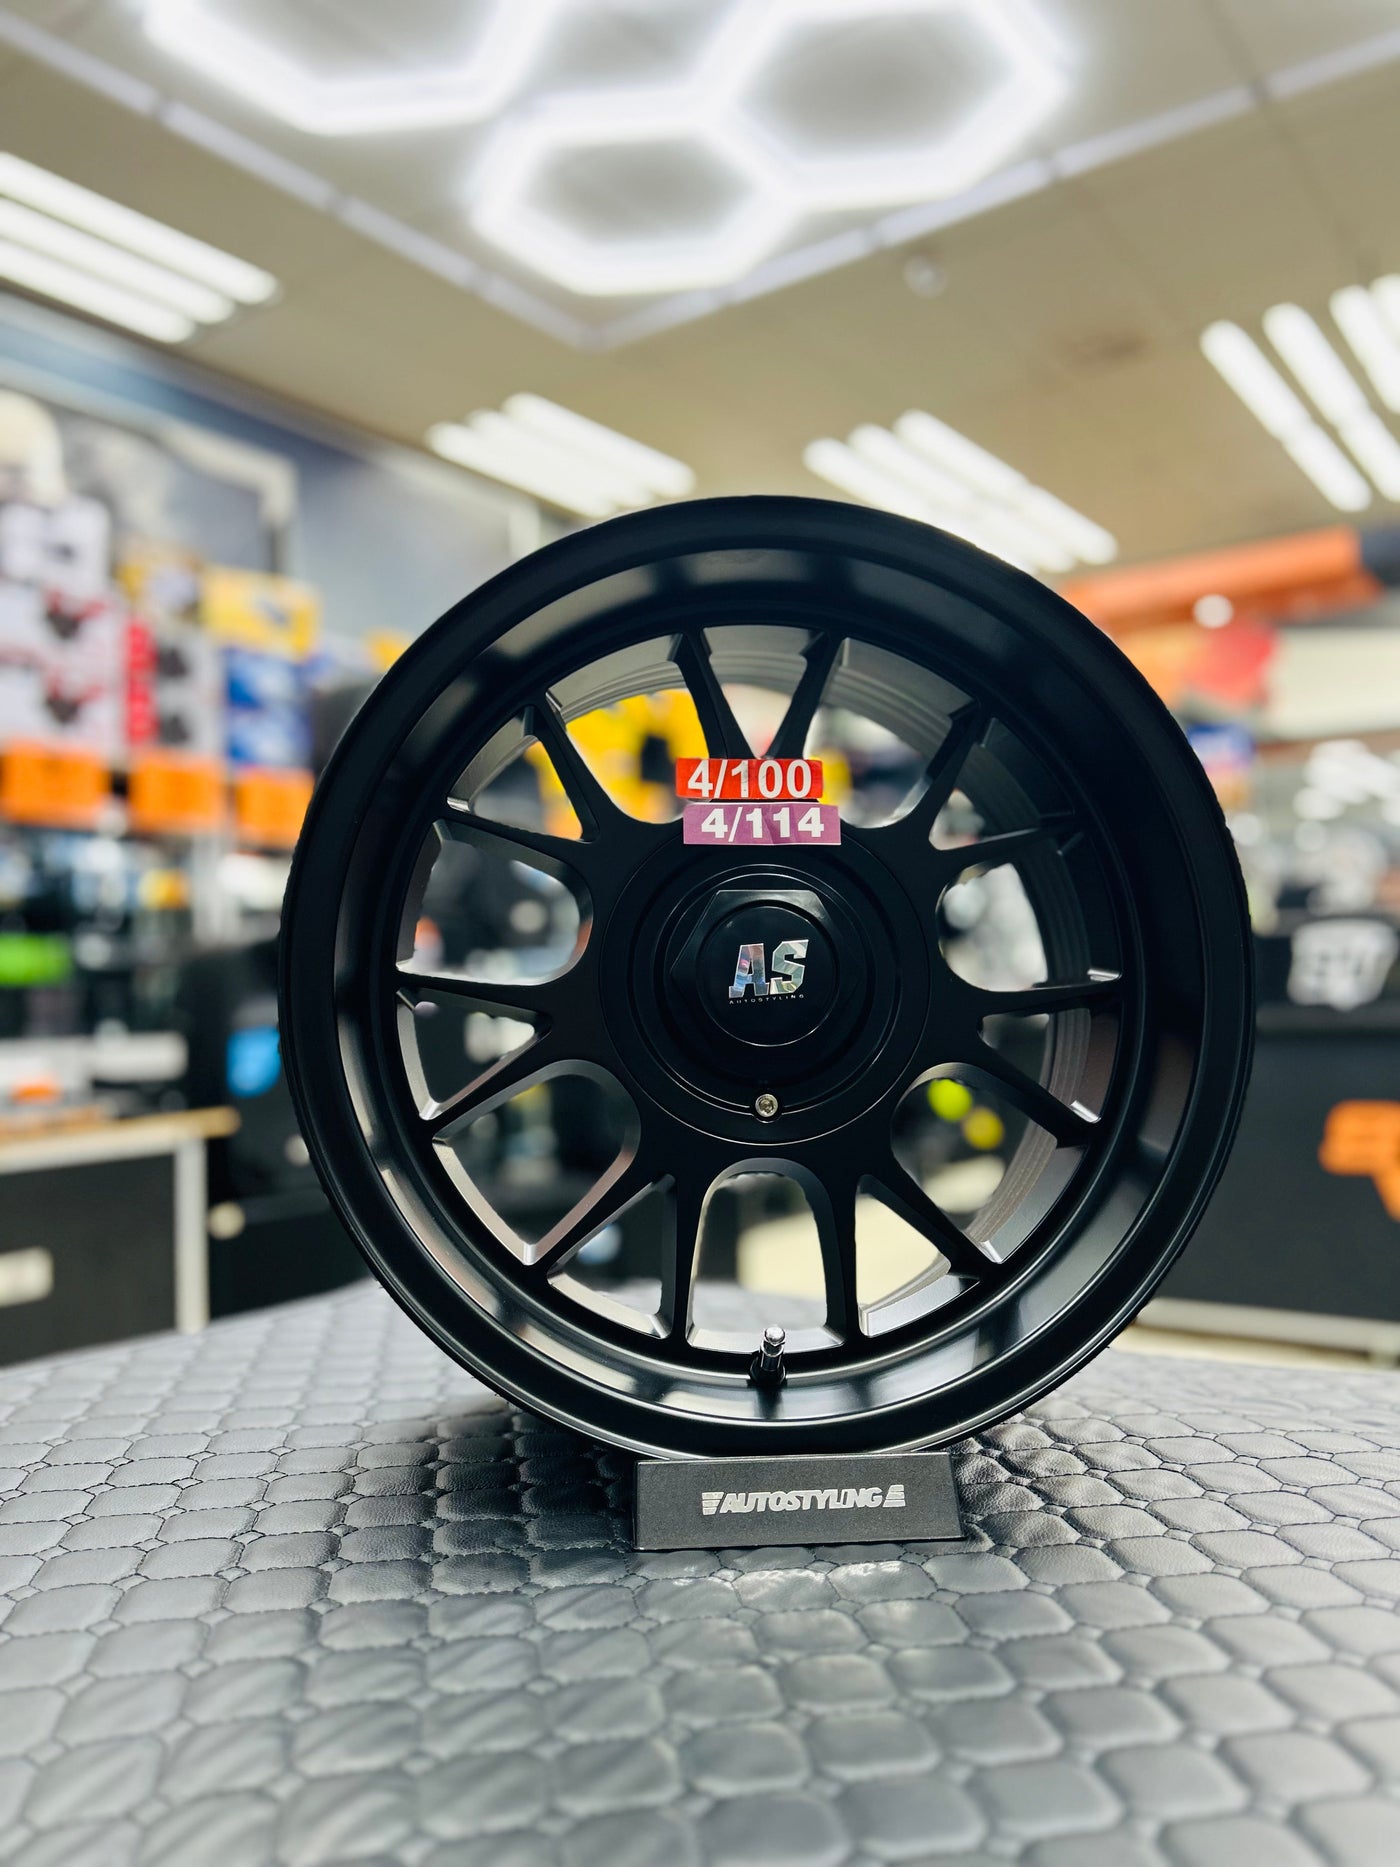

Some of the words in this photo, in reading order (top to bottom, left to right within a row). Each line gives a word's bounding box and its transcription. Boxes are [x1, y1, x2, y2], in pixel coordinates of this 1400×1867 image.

[688, 759, 812, 799] 4/100
[701, 807, 825, 842] 4/114
[728, 938, 809, 999] AS
[729, 994, 804, 1005] AUTOSTYLING
[719, 1487, 883, 1514] AUTOSTYLING
